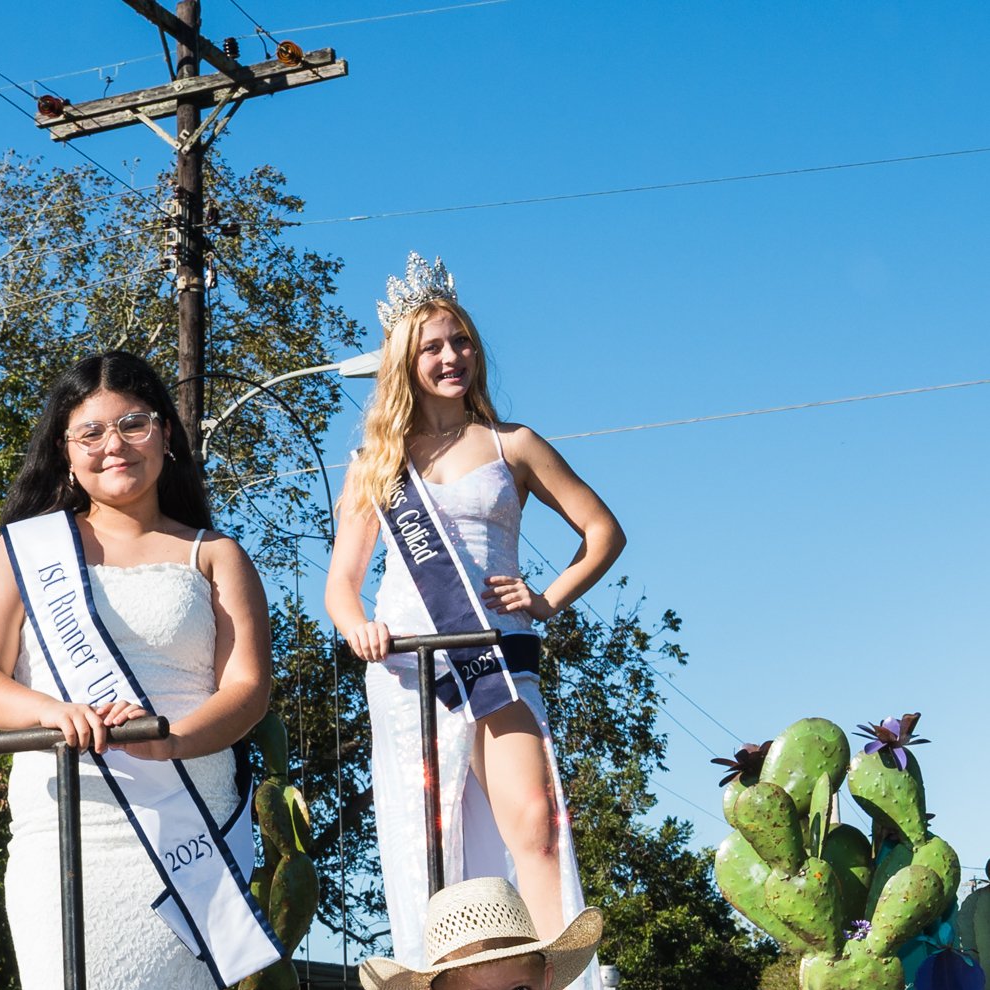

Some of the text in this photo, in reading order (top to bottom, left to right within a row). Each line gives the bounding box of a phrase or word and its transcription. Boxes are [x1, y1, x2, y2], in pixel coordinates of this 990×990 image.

[396, 509, 439, 566] Goliad
[38, 562, 69, 592] 1st
[48, 590, 99, 669] Runner
[461, 651, 496, 681] 2025
[165, 833, 213, 873] 2025
